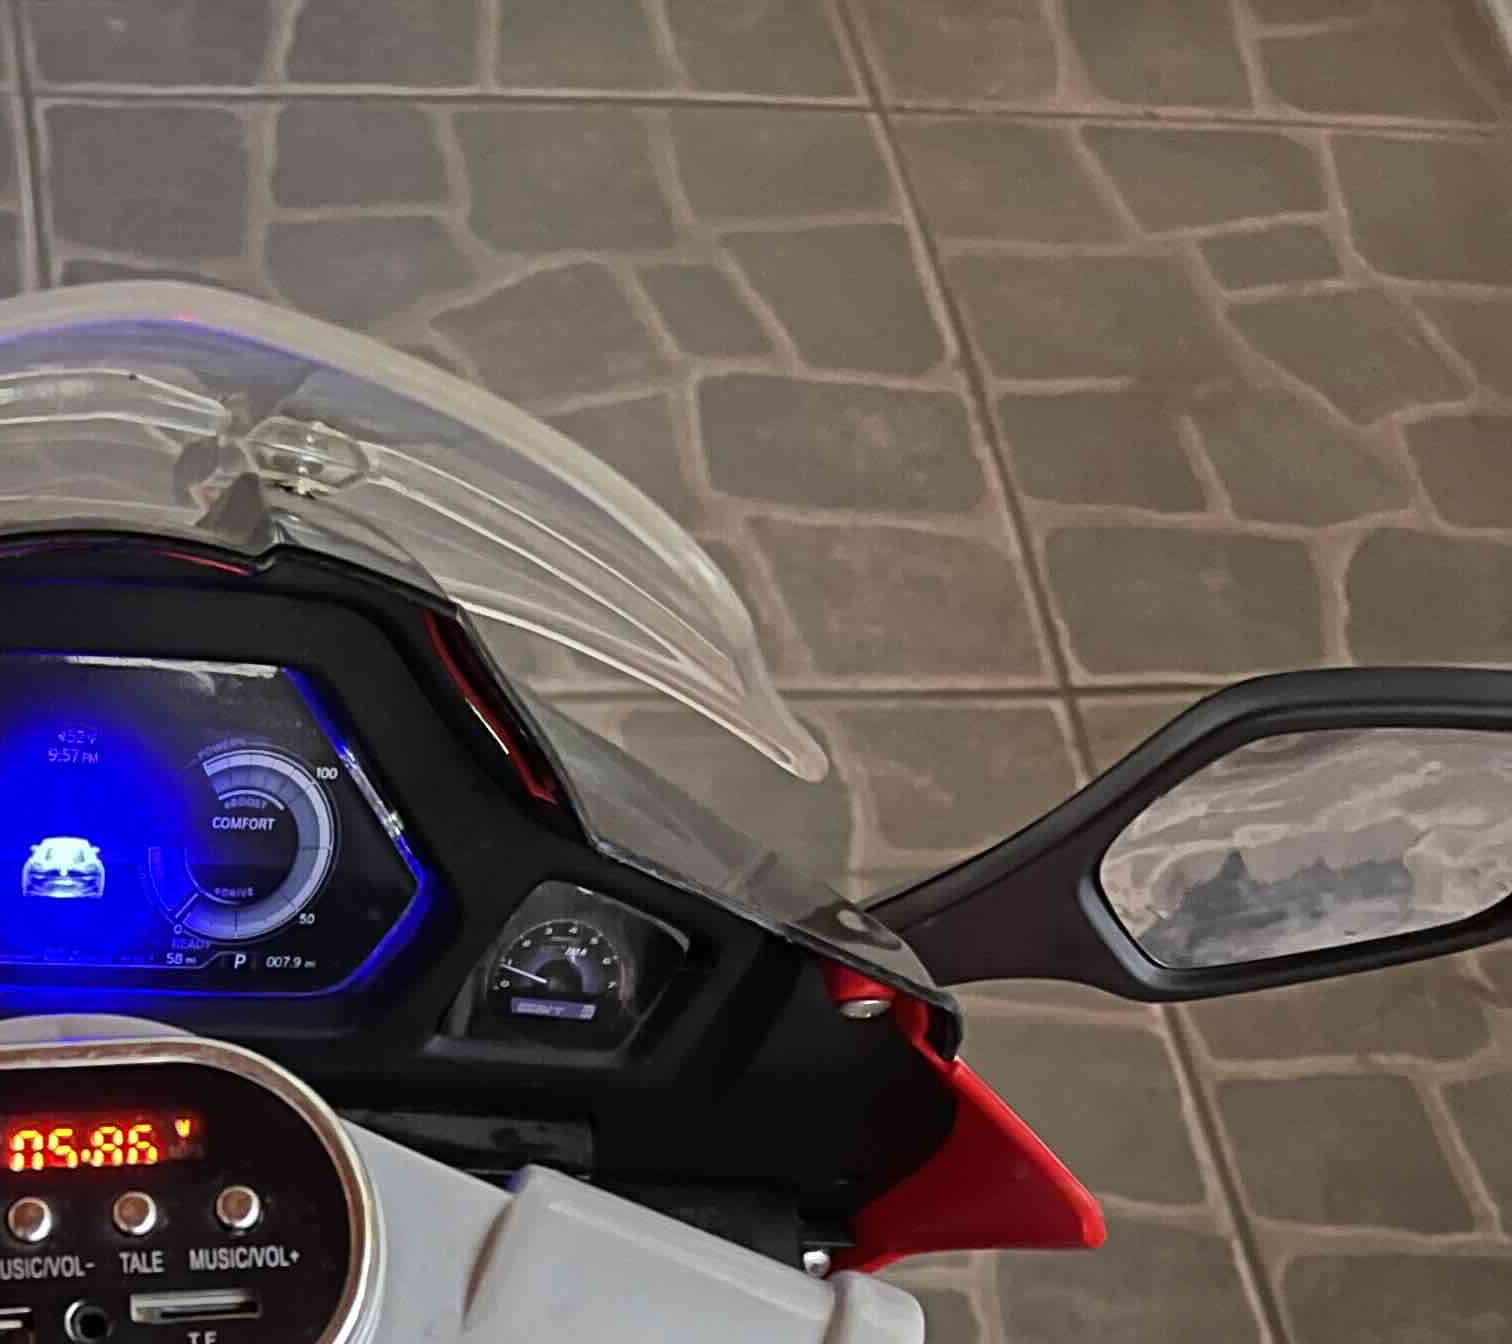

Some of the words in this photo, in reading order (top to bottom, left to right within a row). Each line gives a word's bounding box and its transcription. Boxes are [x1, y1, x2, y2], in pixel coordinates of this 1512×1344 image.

[316, 767, 338, 780] 100
[212, 816, 275, 832] COMFORT
[299, 913, 315, 925] 50
[174, 924, 183, 935] 0
[234, 953, 247, 969] P
[266, 956, 302, 969] 007.9
[119, 1250, 164, 1275] TALE
[189, 1246, 300, 1271] MUSIC/VOL+
